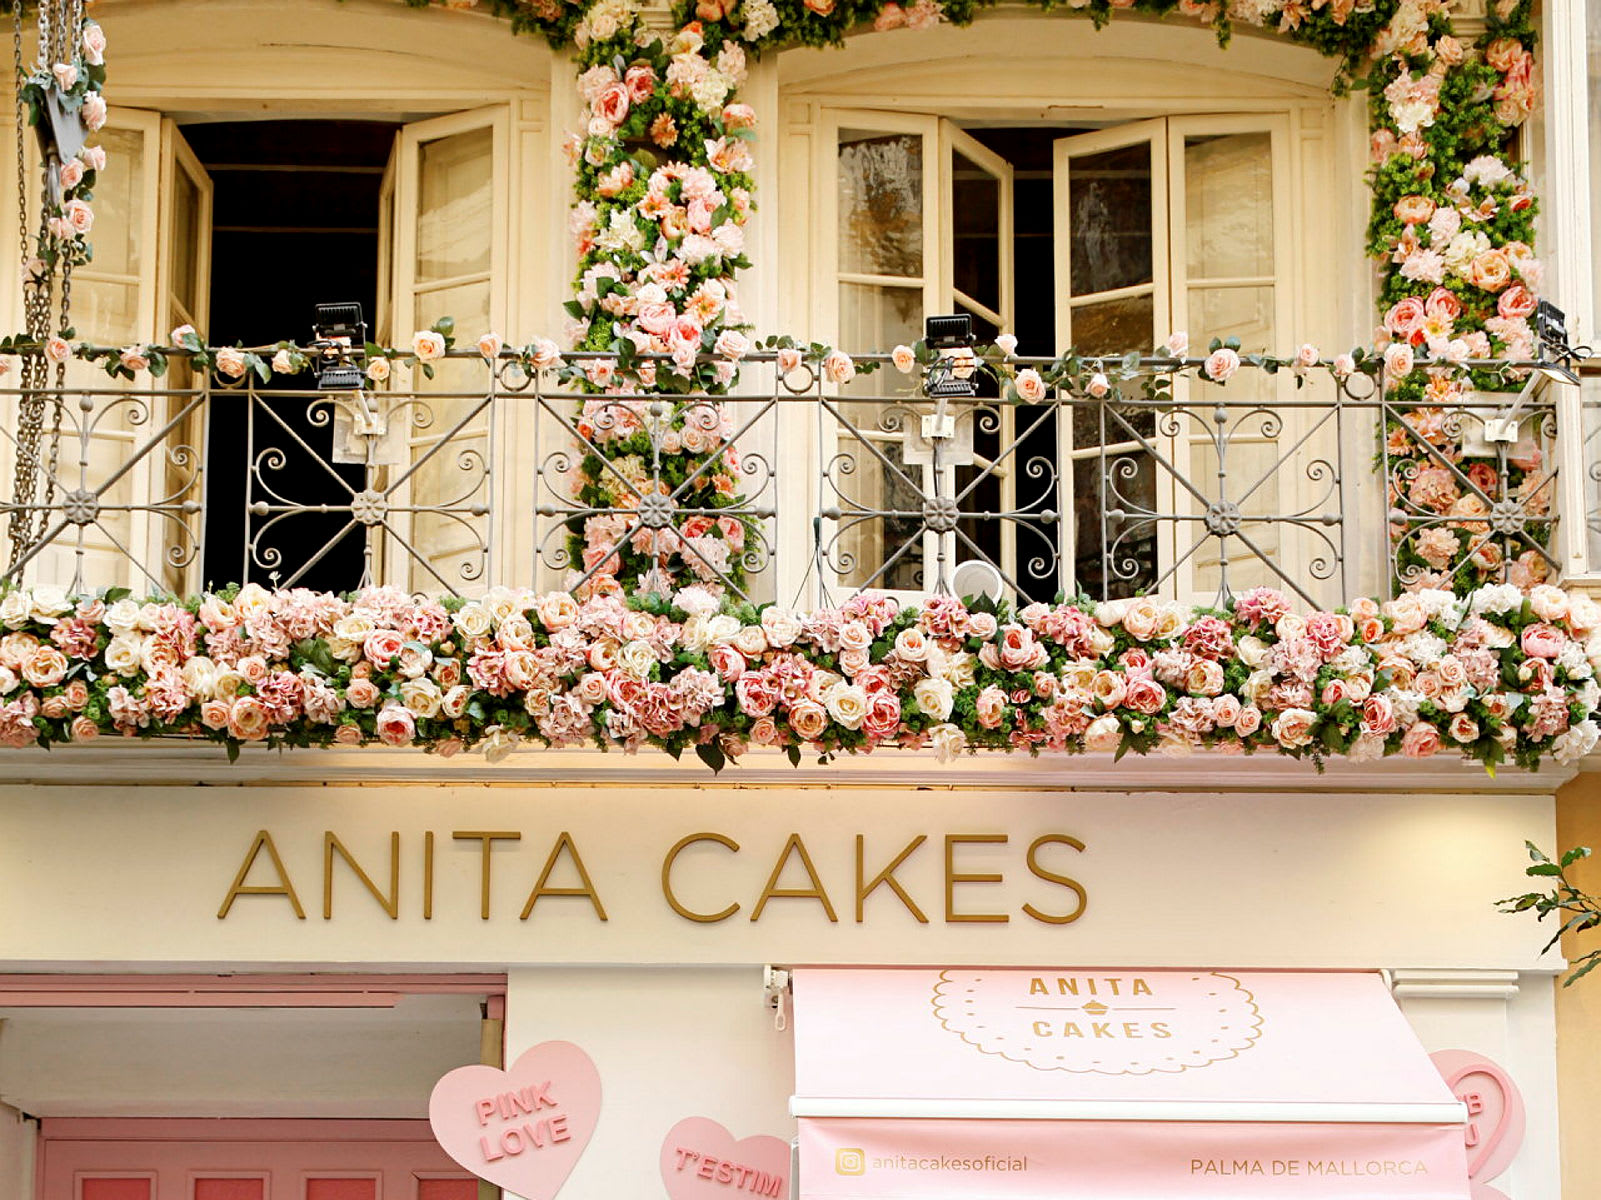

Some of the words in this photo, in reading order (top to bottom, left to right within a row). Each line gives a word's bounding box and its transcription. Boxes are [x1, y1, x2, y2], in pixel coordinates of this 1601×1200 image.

[218, 830, 608, 922] ANITA
[661, 832, 1088, 925] CAKES
[1029, 977, 1153, 996] ANITA
[1032, 1021, 1175, 1039] CAKES
[475, 1080, 558, 1126] PINK
[479, 1114, 572, 1163] LOVE
[675, 1147, 784, 1198] T'ESTIM
[872, 1154, 1028, 1172] anitacakesoficial
[1190, 1158, 1264, 1175] PALMA
[1272, 1159, 1300, 1176] DE
[1307, 1159, 1428, 1176] MALLORCA
